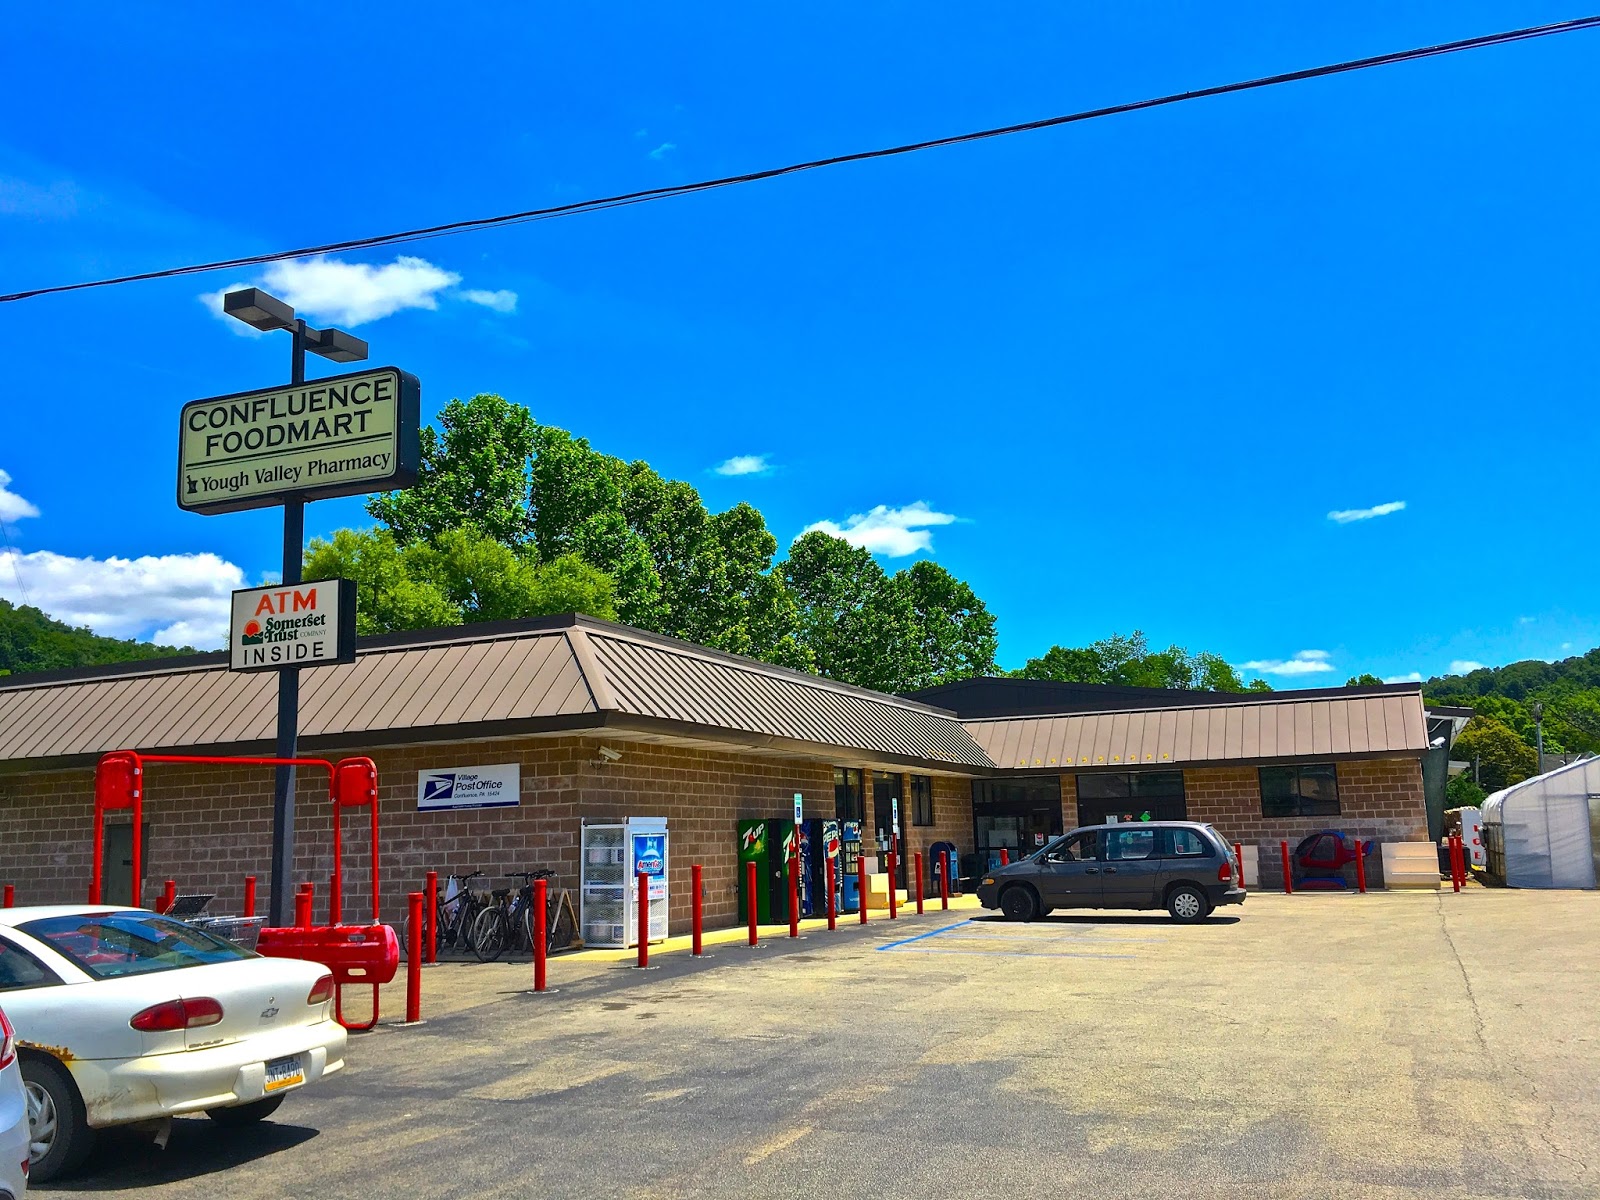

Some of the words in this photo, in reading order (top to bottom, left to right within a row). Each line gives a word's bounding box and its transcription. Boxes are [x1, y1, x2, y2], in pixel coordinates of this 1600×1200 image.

[188, 377, 392, 432] CONFLUENCE
[205, 408, 372, 457] FOODMART
[200, 470, 249, 492] Yough
[254, 465, 302, 482] Valley
[307, 452, 391, 477] Pharmacy
[254, 588, 317, 616] ATM
[265, 613, 326, 631] Somerset
[264, 628, 299, 643] Trust
[244, 641, 324, 665] INSIDE
[457, 774, 479, 782] Village
